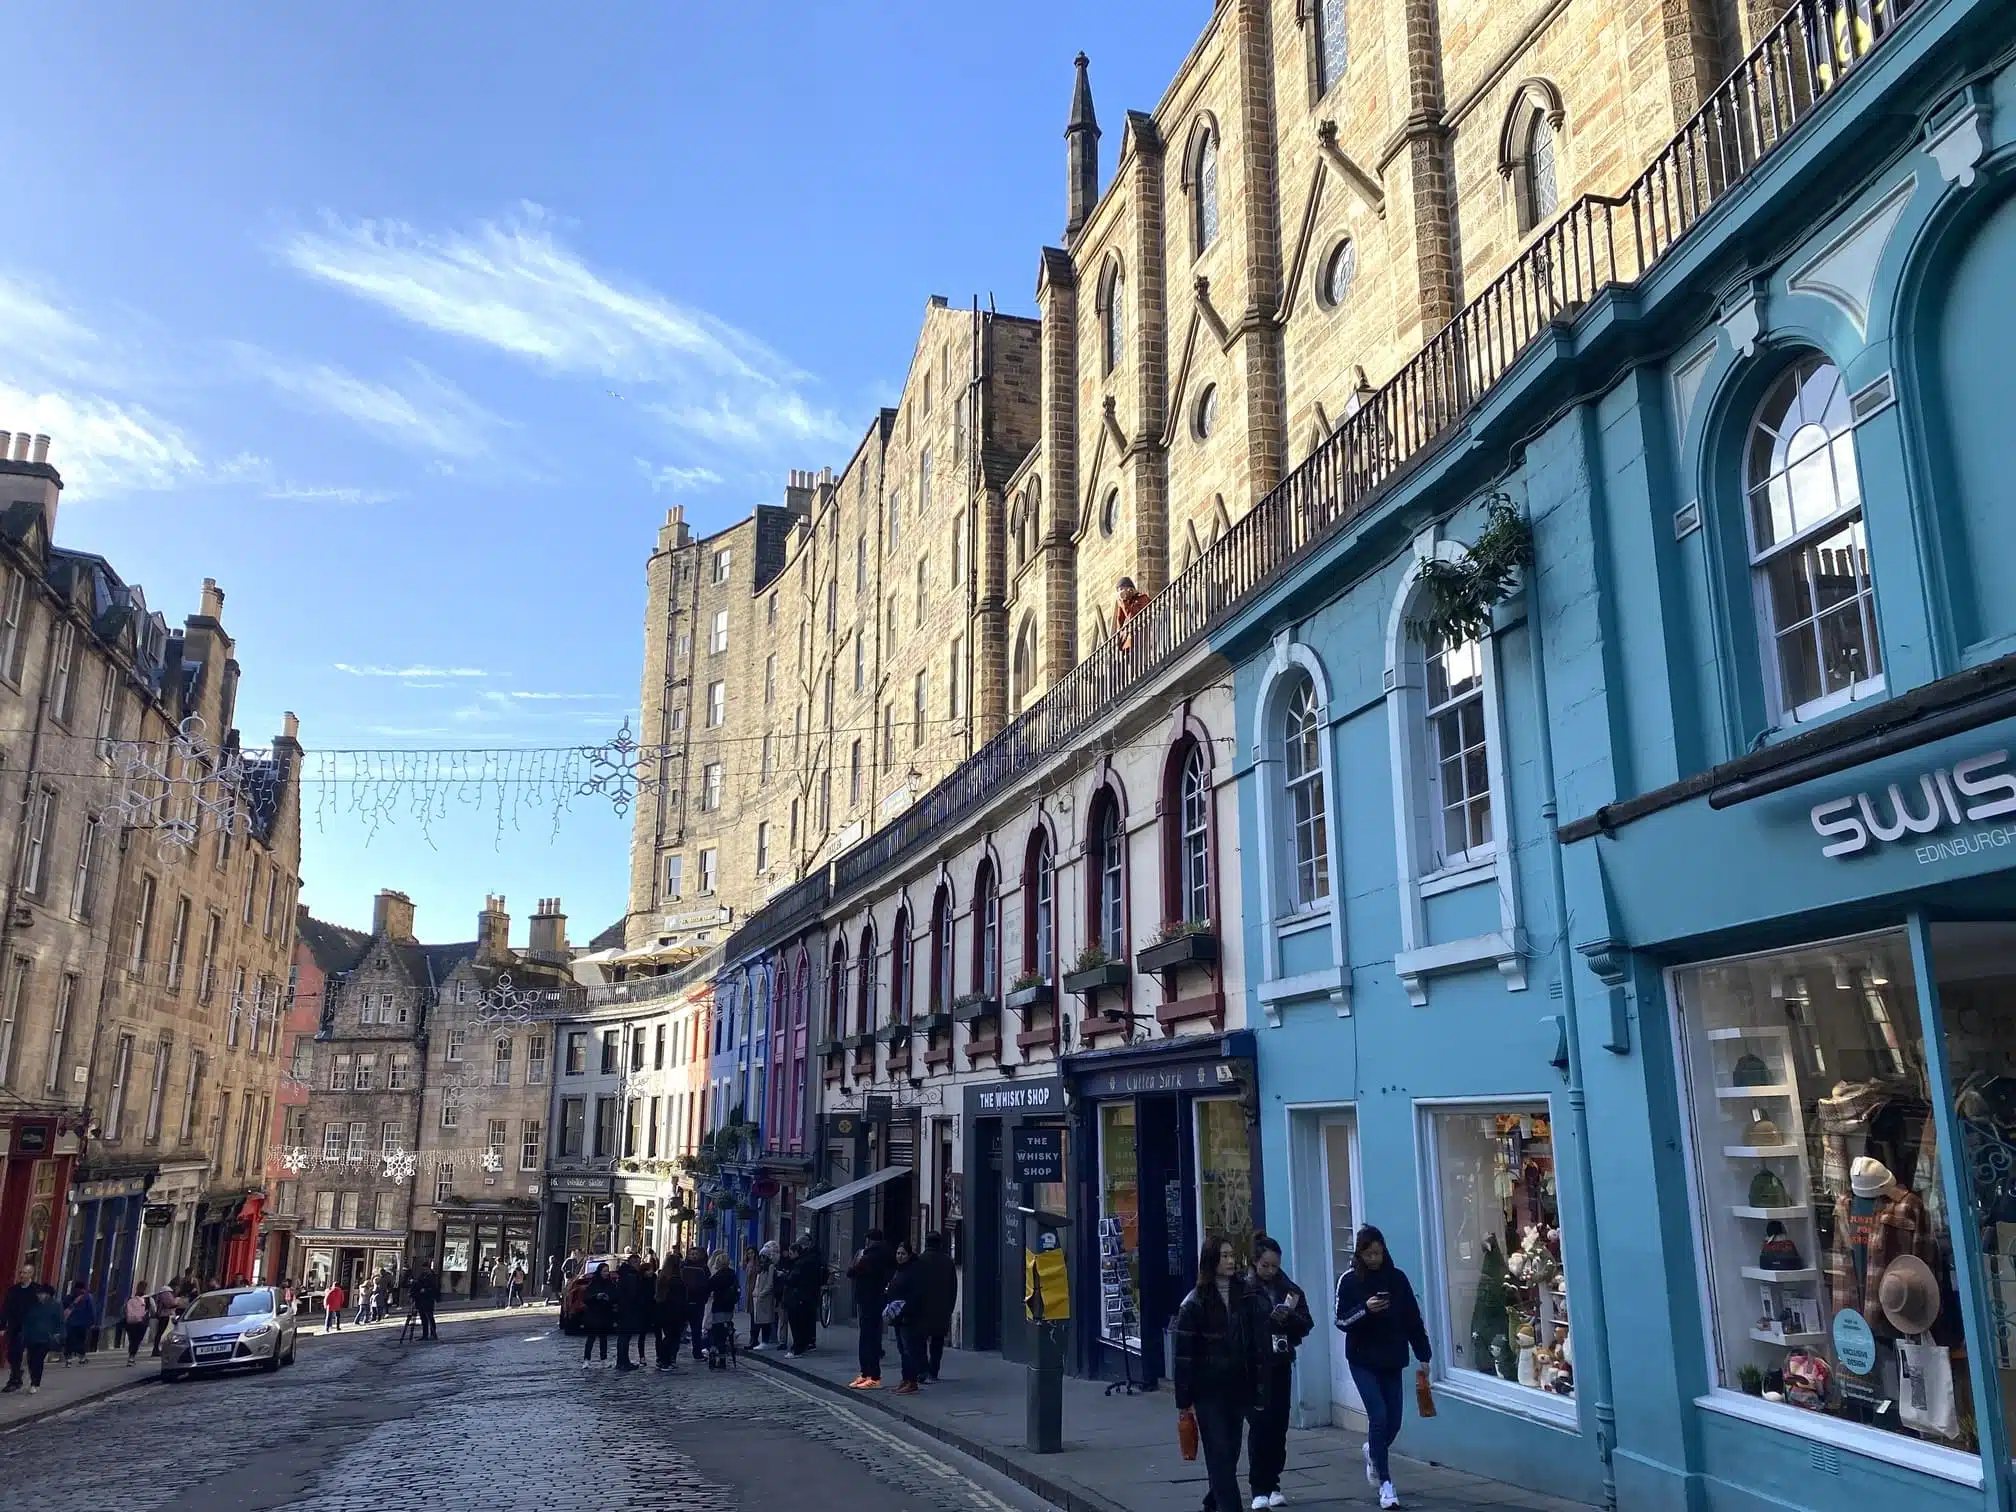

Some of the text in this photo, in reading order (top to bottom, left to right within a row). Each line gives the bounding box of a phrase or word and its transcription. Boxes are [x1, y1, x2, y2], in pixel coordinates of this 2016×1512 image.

[1915, 825, 2016, 865] EDINBURGH
[1159, 1068, 1184, 1089] Sark
[980, 1087, 1050, 1109] THE WHISKY SHOP
[1027, 1137, 1048, 1145] THE
[1016, 1152, 1059, 1161] WHISKY
[1023, 1167, 1052, 1176] SHOP
